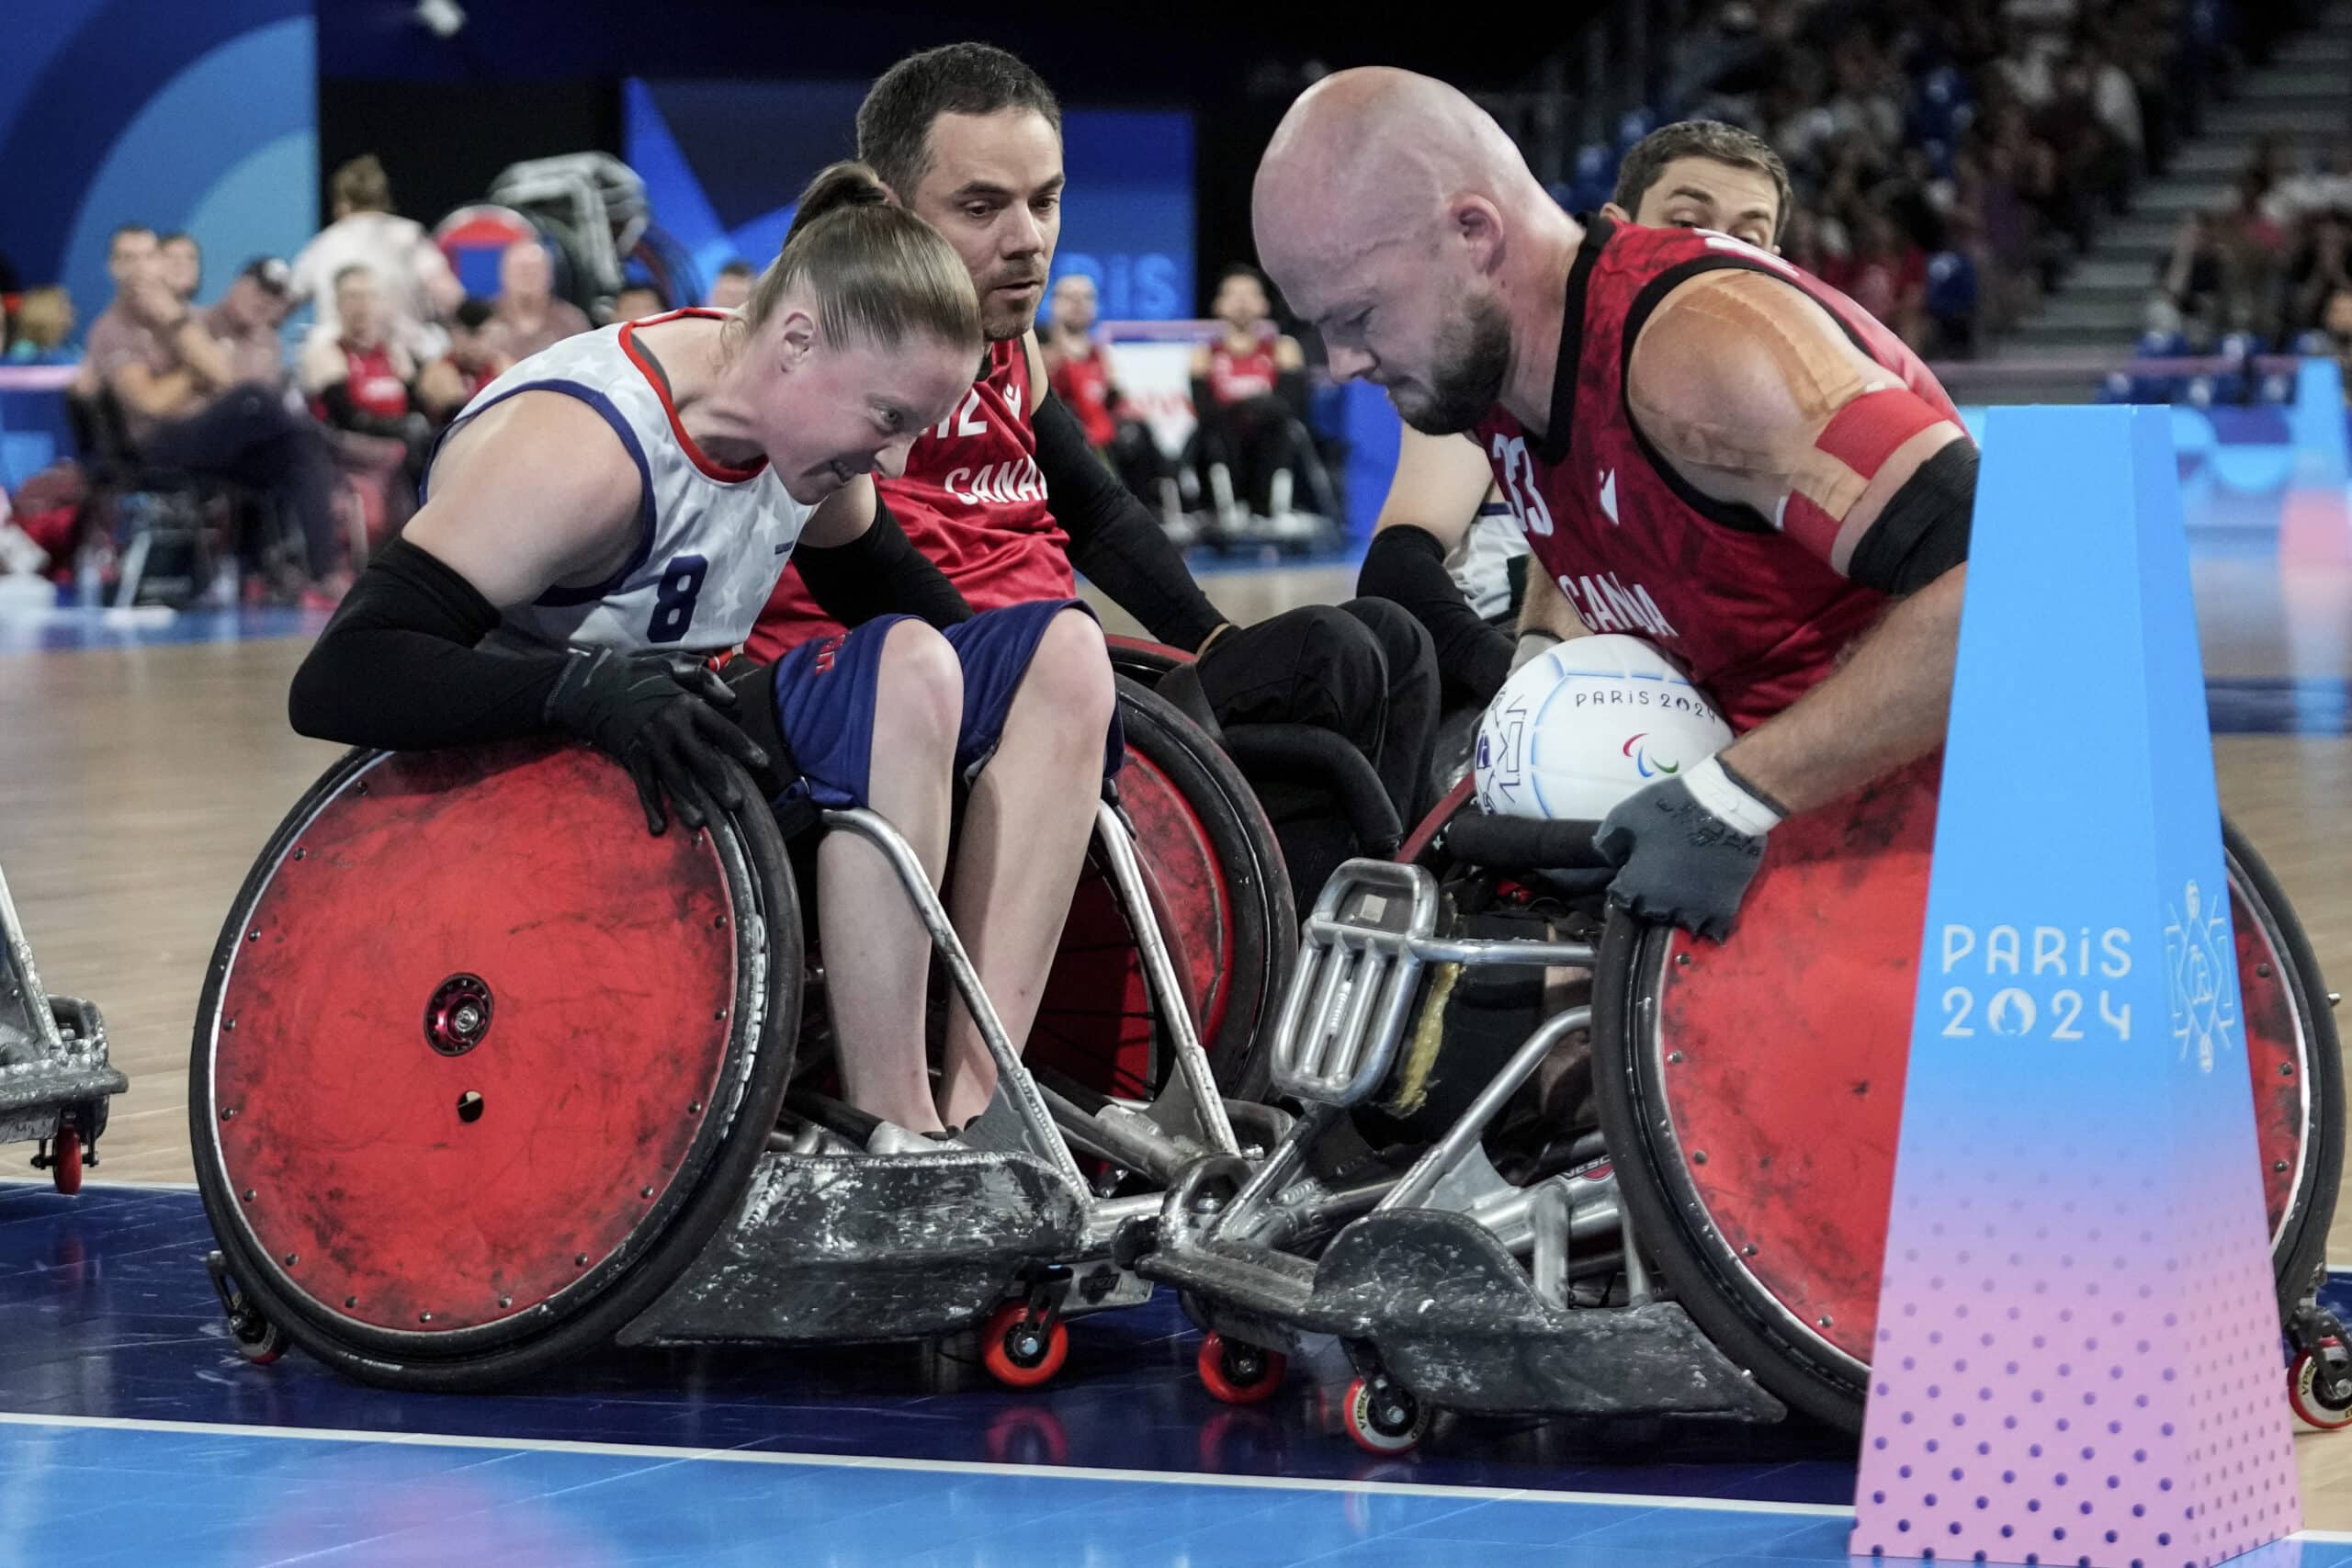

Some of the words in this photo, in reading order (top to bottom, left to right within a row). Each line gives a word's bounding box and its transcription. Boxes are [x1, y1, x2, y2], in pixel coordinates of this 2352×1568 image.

[1492, 433, 1554, 536] 33
[647, 554, 707, 643] 8
[1558, 570, 1679, 637] CANA
[1660, 693, 1716, 724] 2024
[1940, 986, 2132, 1041] 2024
